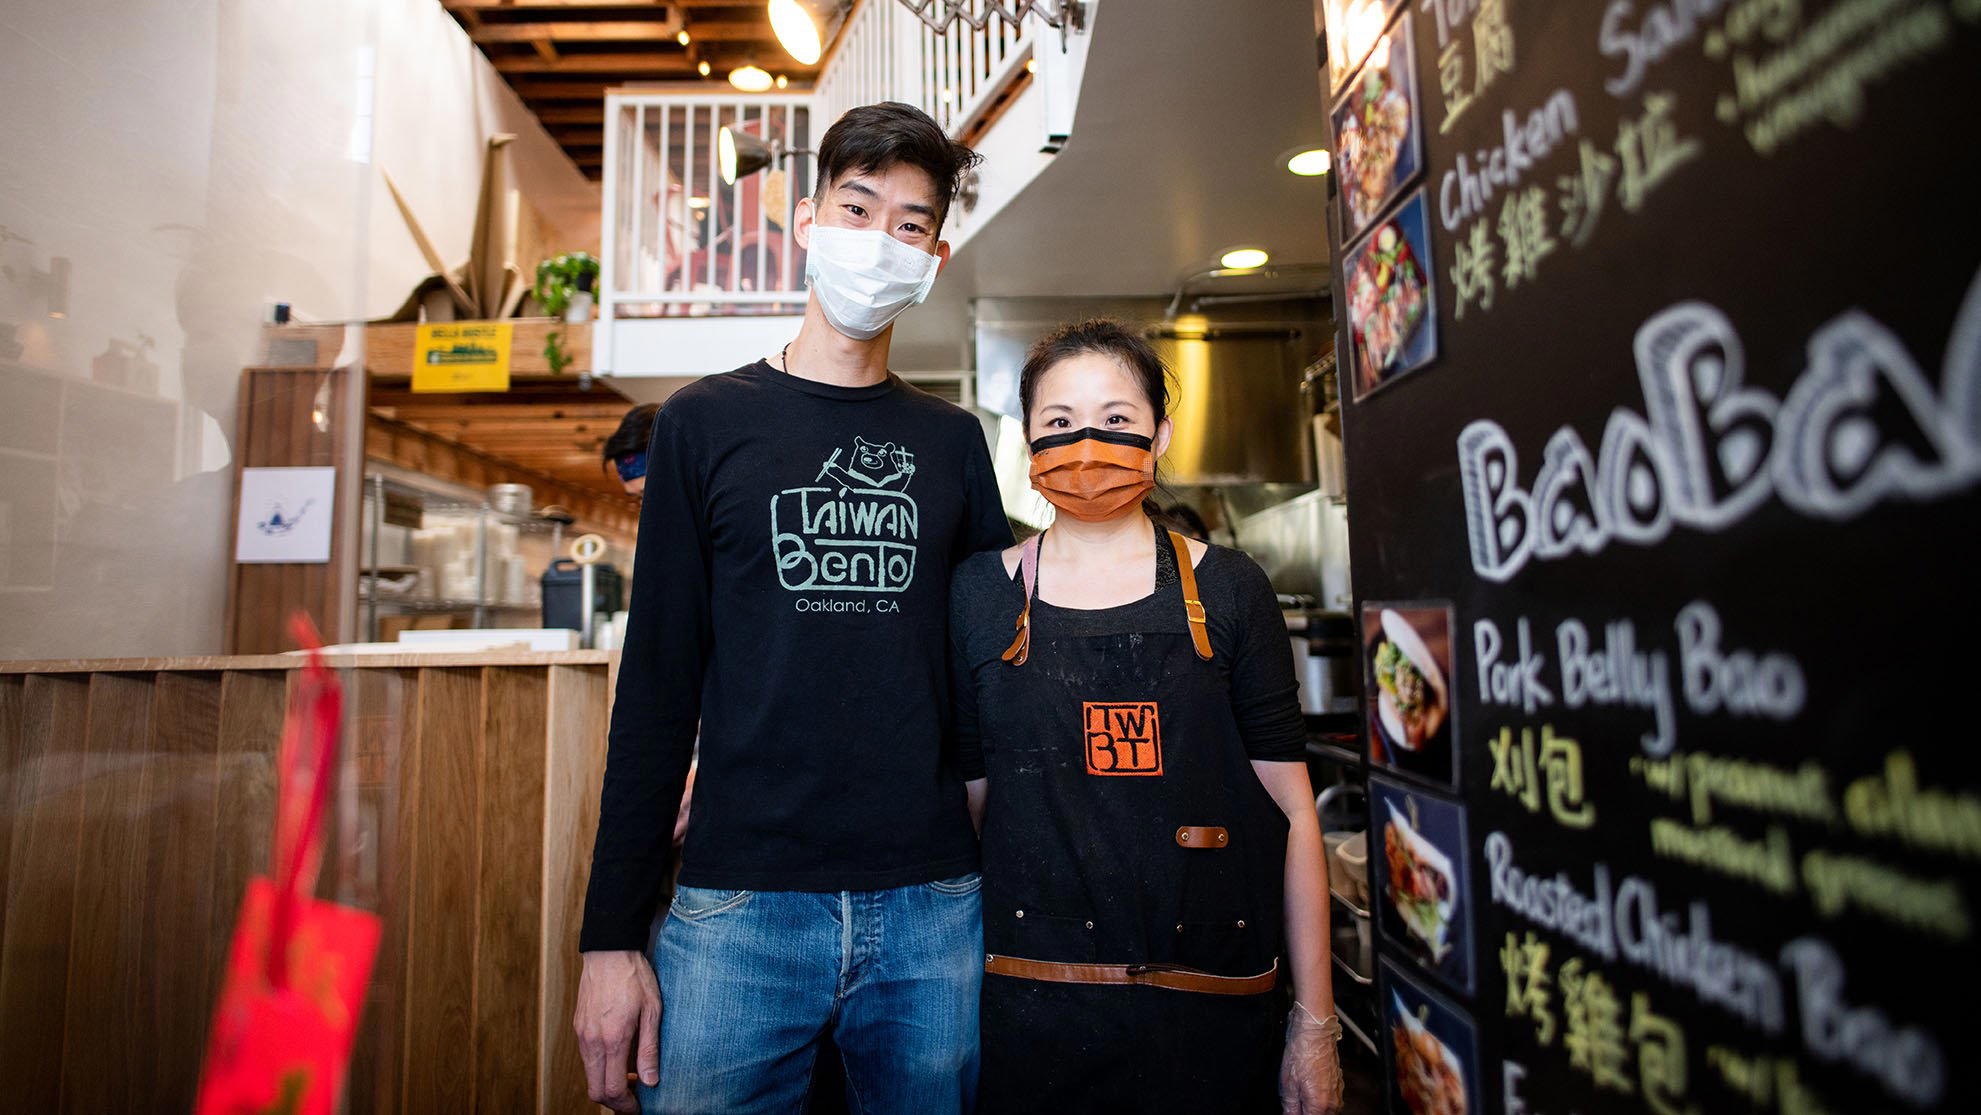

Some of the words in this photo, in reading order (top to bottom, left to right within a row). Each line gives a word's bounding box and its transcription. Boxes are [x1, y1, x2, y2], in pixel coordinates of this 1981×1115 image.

[1440, 90, 1578, 231] Chicken
[795, 598, 871, 613] Oakland,
[875, 600, 900, 613] CA
[1474, 616, 1551, 714] Pork
[1556, 618, 1676, 757] Belly
[1675, 600, 1805, 718] Bao
[1485, 831, 1617, 960] Roasted
[1615, 877, 1784, 1035] Chicken
[1781, 938, 1945, 1108] Bao
